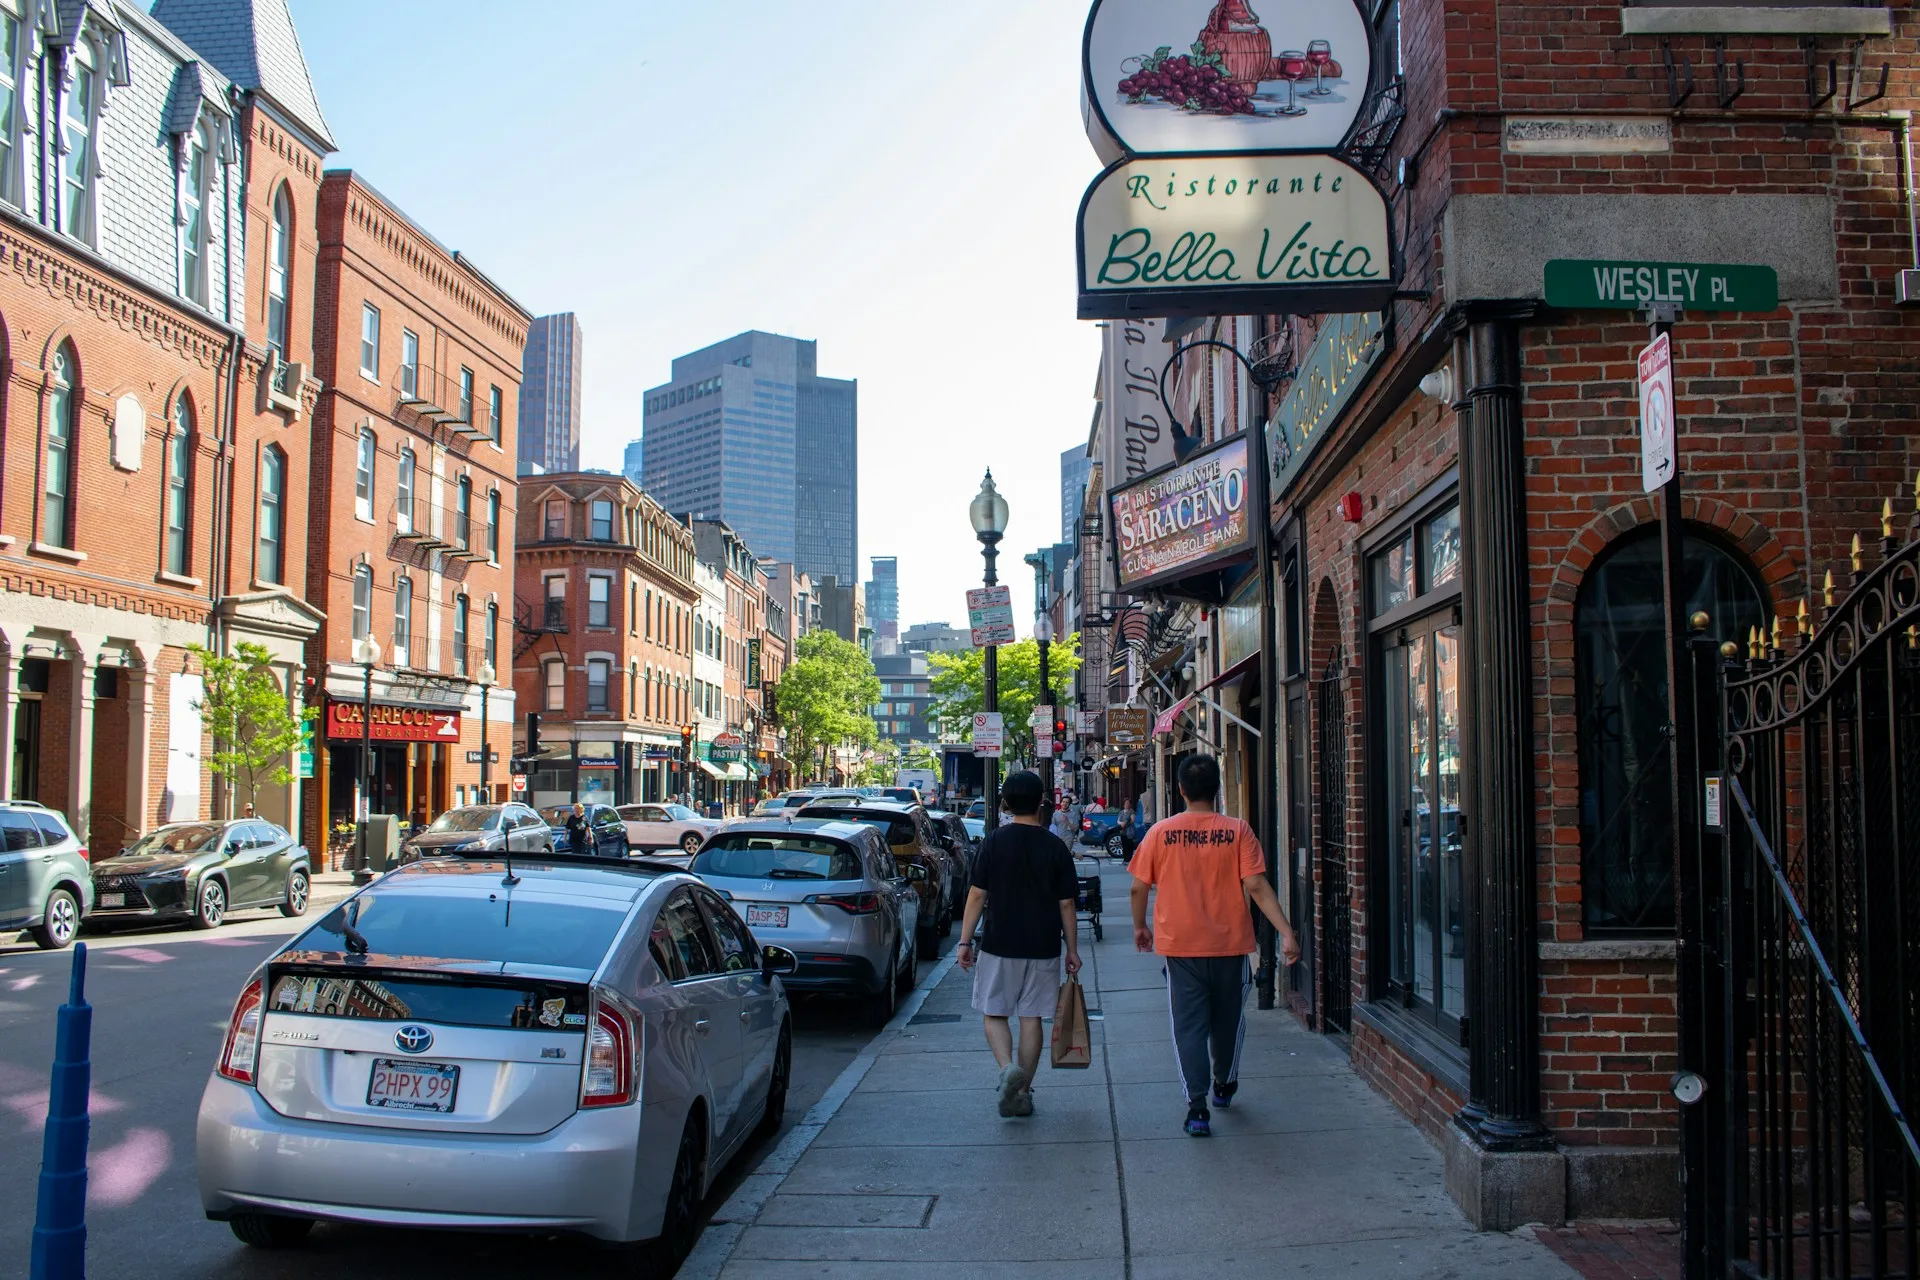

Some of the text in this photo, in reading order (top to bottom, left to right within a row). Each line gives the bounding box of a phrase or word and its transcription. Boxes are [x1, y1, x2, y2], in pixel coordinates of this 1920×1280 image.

[1126, 171, 1343, 210] Ristorante
[1096, 221, 1380, 284] Bella Vista
[1593, 266, 1735, 303] WESLEY PL
[1293, 365, 1329, 456] Bella
[1135, 457, 1221, 511] RISTORANTE
[1120, 467, 1244, 552] SARACENO
[1126, 522, 1241, 574] CUCINA NAPOLETANA
[339, 726, 430, 739] RISORANTE
[712, 749, 739, 759] PASTRY
[1164, 829, 1235, 848] JUST FORGE AHEAD
[749, 910, 787, 923] 3ASP 52
[272, 1031, 320, 1041] PRIUS
[373, 1072, 452, 1100] 2HPX 99
[384, 1099, 415, 1110] Albrecht
